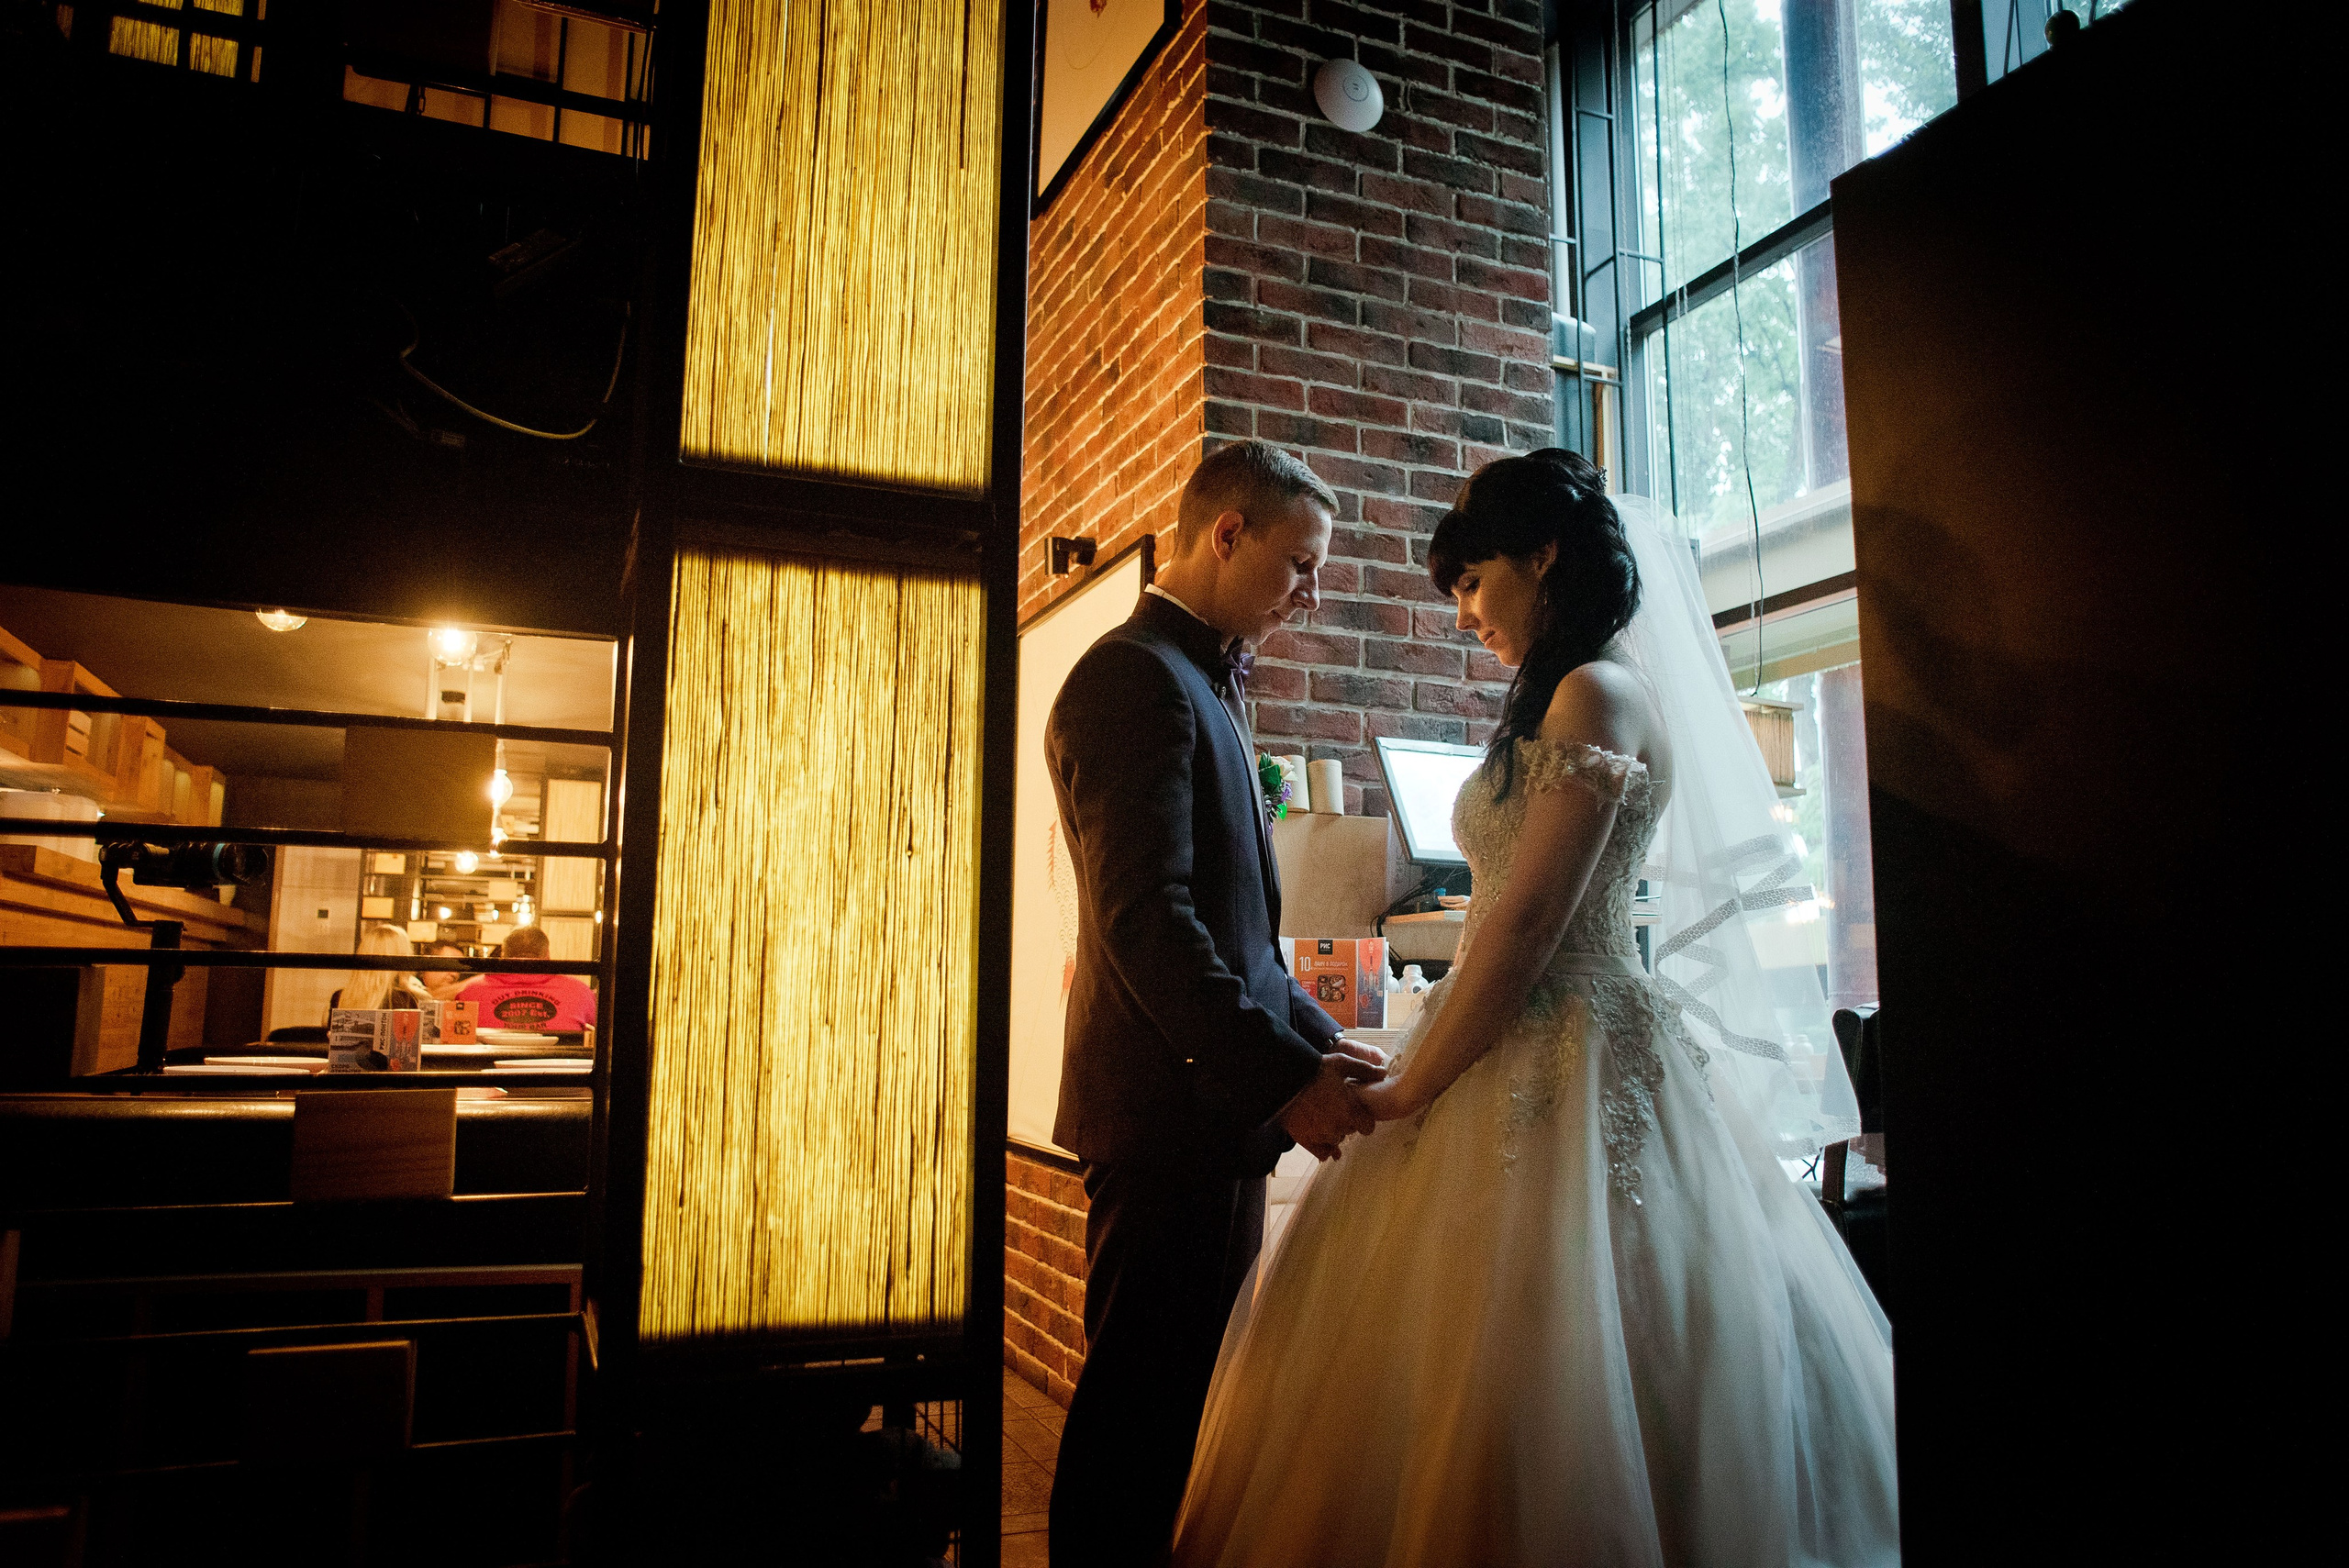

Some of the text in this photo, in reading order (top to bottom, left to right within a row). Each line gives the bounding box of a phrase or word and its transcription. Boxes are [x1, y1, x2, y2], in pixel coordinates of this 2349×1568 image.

[1298, 956, 1311, 972] 10
[514, 990, 561, 1006] DRINKING
[501, 1009, 528, 1018] 2007
[379, 1012, 388, 1051] РИС-ПОНТОН
